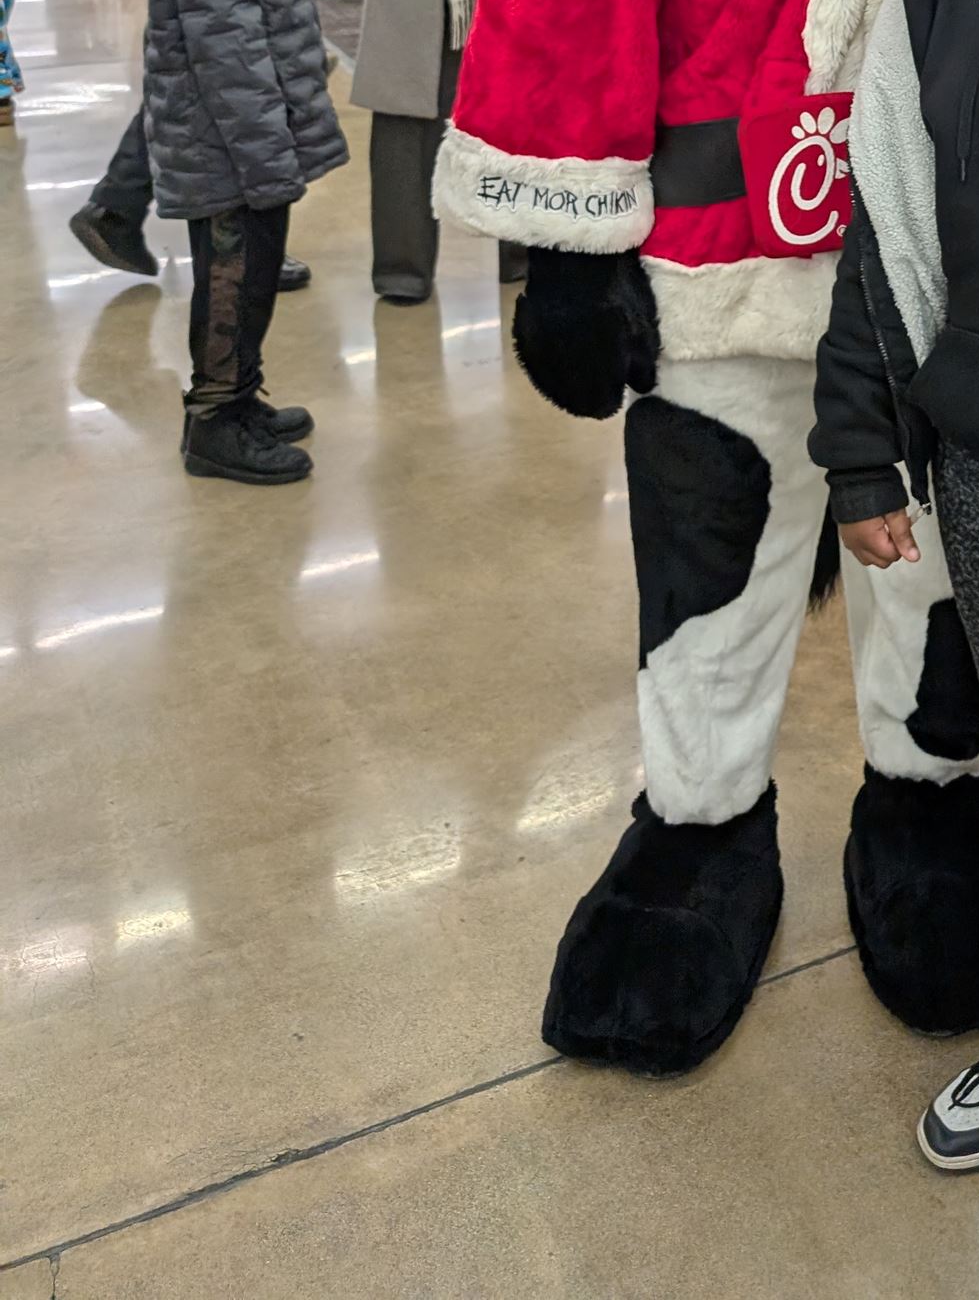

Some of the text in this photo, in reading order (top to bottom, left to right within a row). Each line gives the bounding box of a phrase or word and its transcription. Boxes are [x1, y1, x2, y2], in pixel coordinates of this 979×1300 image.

[477, 176, 637, 219] EAT MOR CHIKIN
